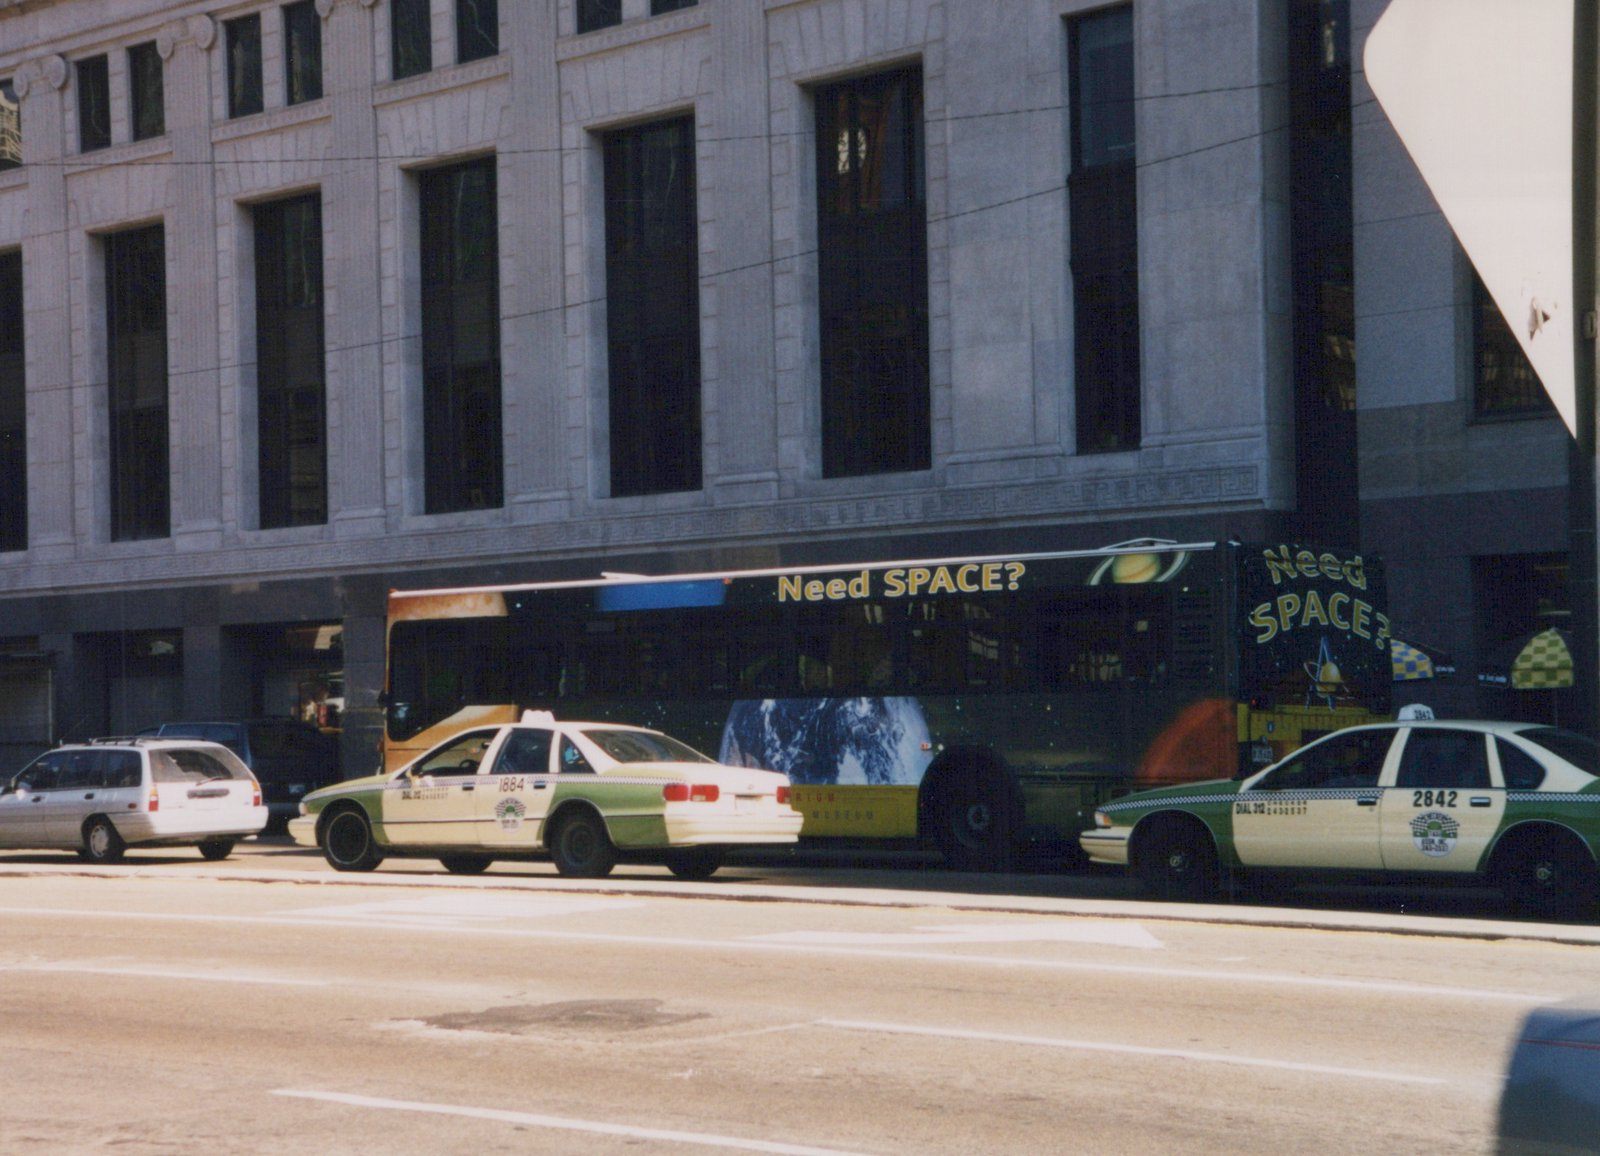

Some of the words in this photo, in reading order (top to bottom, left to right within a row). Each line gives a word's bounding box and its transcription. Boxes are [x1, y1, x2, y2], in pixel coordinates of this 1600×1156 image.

[778, 569, 870, 602] Need
[884, 562, 1026, 597] SPACE?
[1263, 545, 1367, 590] Need
[1248, 590, 1391, 650] SPACE?
[499, 777, 524, 792] 1884
[1412, 790, 1458, 807] 2842
